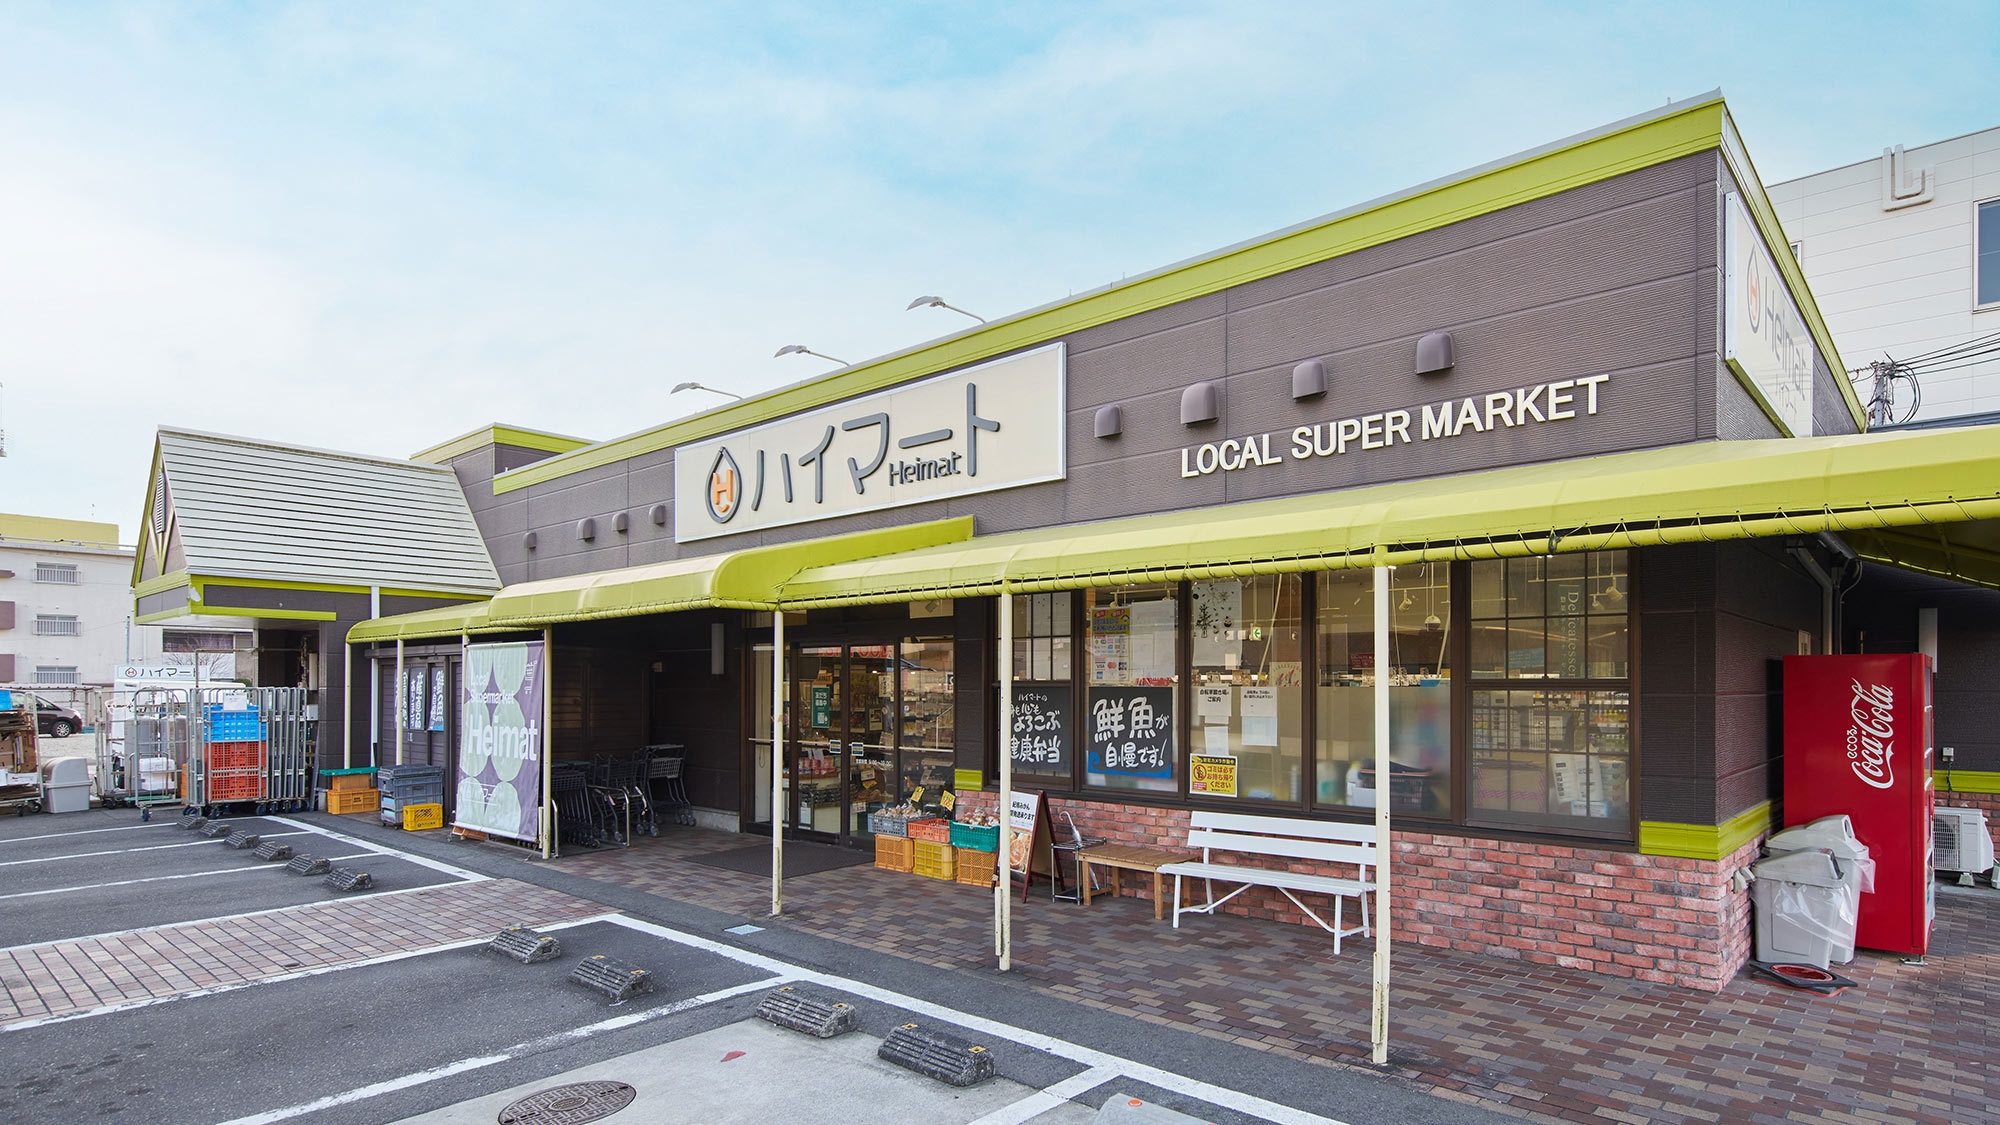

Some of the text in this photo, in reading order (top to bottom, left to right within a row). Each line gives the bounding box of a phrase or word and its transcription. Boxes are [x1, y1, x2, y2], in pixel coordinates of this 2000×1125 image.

[1765, 276, 1807, 401] Heimat
[1181, 373, 1610, 478] LOCAL SUPER MARKET
[752, 382, 1000, 512] ハイマート
[889, 450, 963, 487] Heimat
[1018, 693, 1048, 702] ハイマートの
[468, 714, 538, 761] Heimat
[1013, 710, 1061, 733] よろこぶ
[1093, 696, 1170, 743] 鮮魚が
[1851, 677, 1895, 789] Coca-Cola
[1207, 766, 1234, 774] ゴミは必ず
[1207, 773, 1234, 782] お持ち帰り
[1210, 780, 1232, 789] ください
